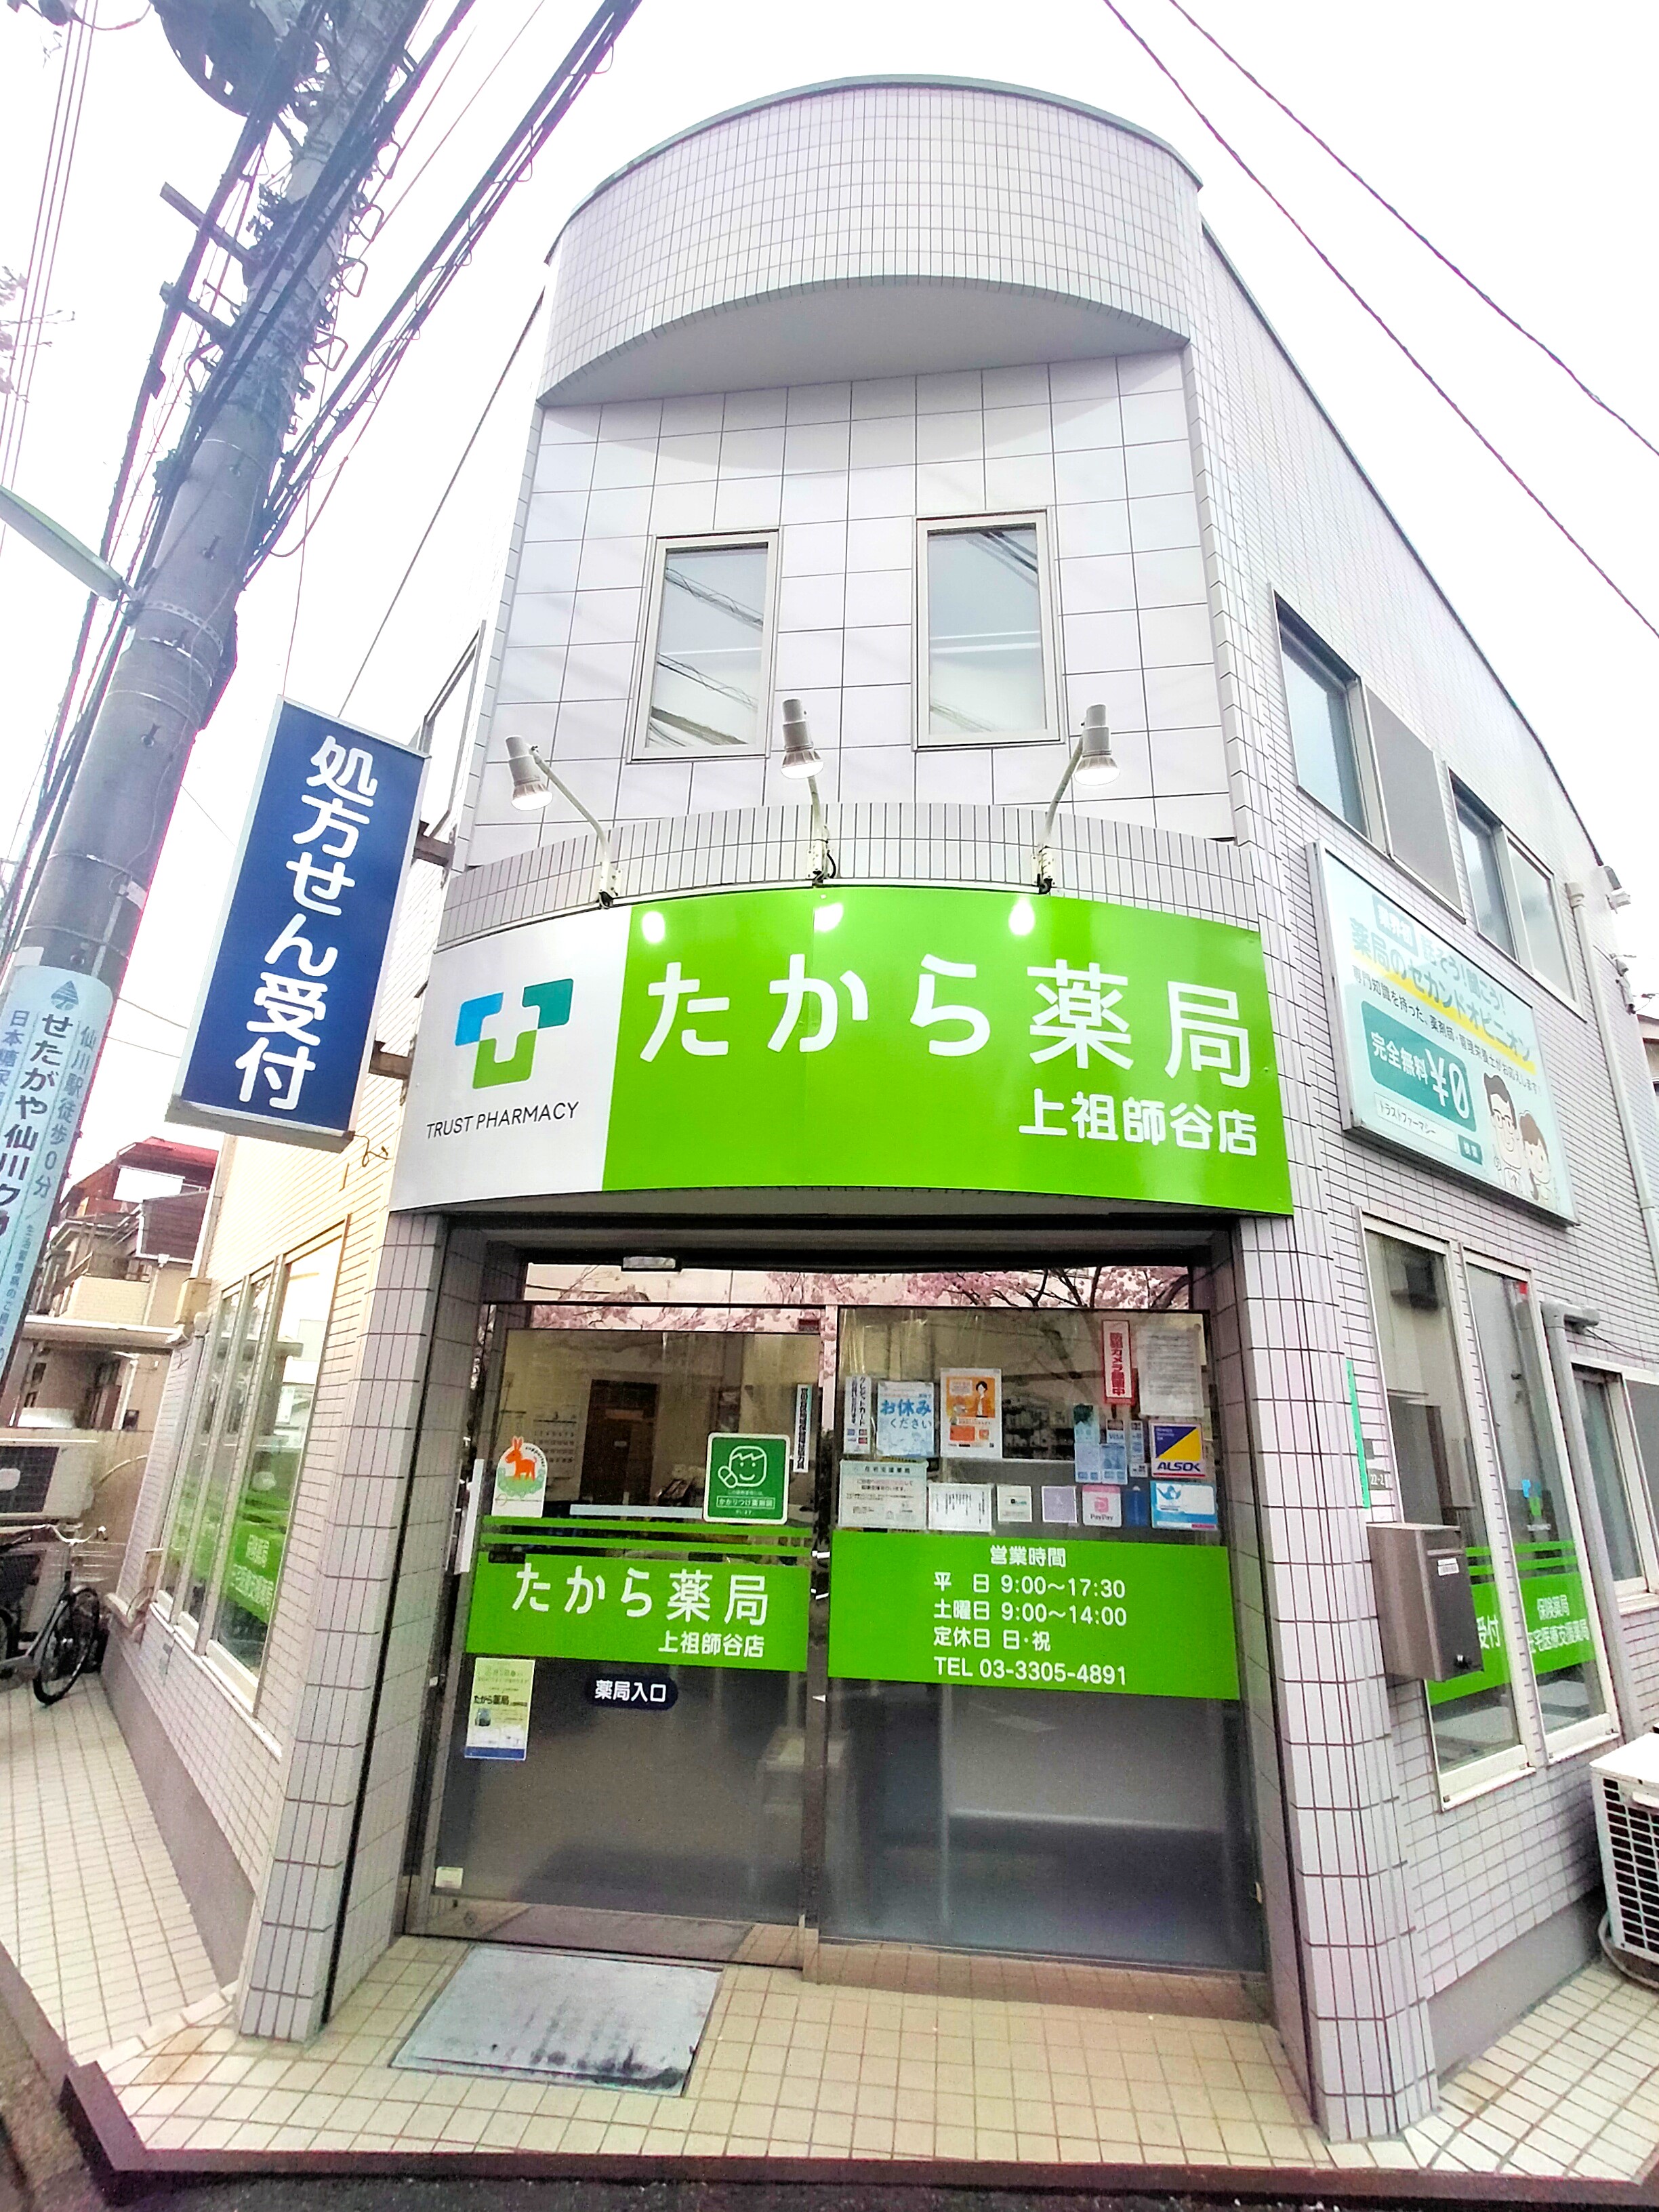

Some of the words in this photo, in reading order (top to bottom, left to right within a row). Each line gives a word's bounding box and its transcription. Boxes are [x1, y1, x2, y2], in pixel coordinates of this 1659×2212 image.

[234, 735, 379, 1110] 処方せん受付
[1349, 917, 1531, 1062] 薬局のセカンドオピニオン
[640, 953, 1250, 1088] たから薬局
[1370, 1031, 1429, 1086] 完全無料
[426, 1115, 473, 1139] TRUST
[476, 1101, 579, 1130] PHARMACY
[1019, 1088, 1257, 1156] 上祖師谷店
[1379, 1100, 1436, 1134] トラストファーマシー
[880, 1399, 932, 1416] お休み
[890, 1418, 933, 1429] ください
[1158, 1462, 1201, 1472] ALSOK
[989, 1545, 1067, 1568] 営業時間
[512, 1563, 769, 1626] たから薬局
[934, 1599, 990, 1622] 土曜日
[658, 1631, 765, 1658] 上祖師谷店
[934, 1626, 990, 1649] 定休日
[1003, 1630, 1052, 1652] 日・祝
[935, 1656, 973, 1677] TEL
[980, 1658, 1126, 1685] 03-3305-4891
[594, 1680, 668, 1703] 薬局入口
